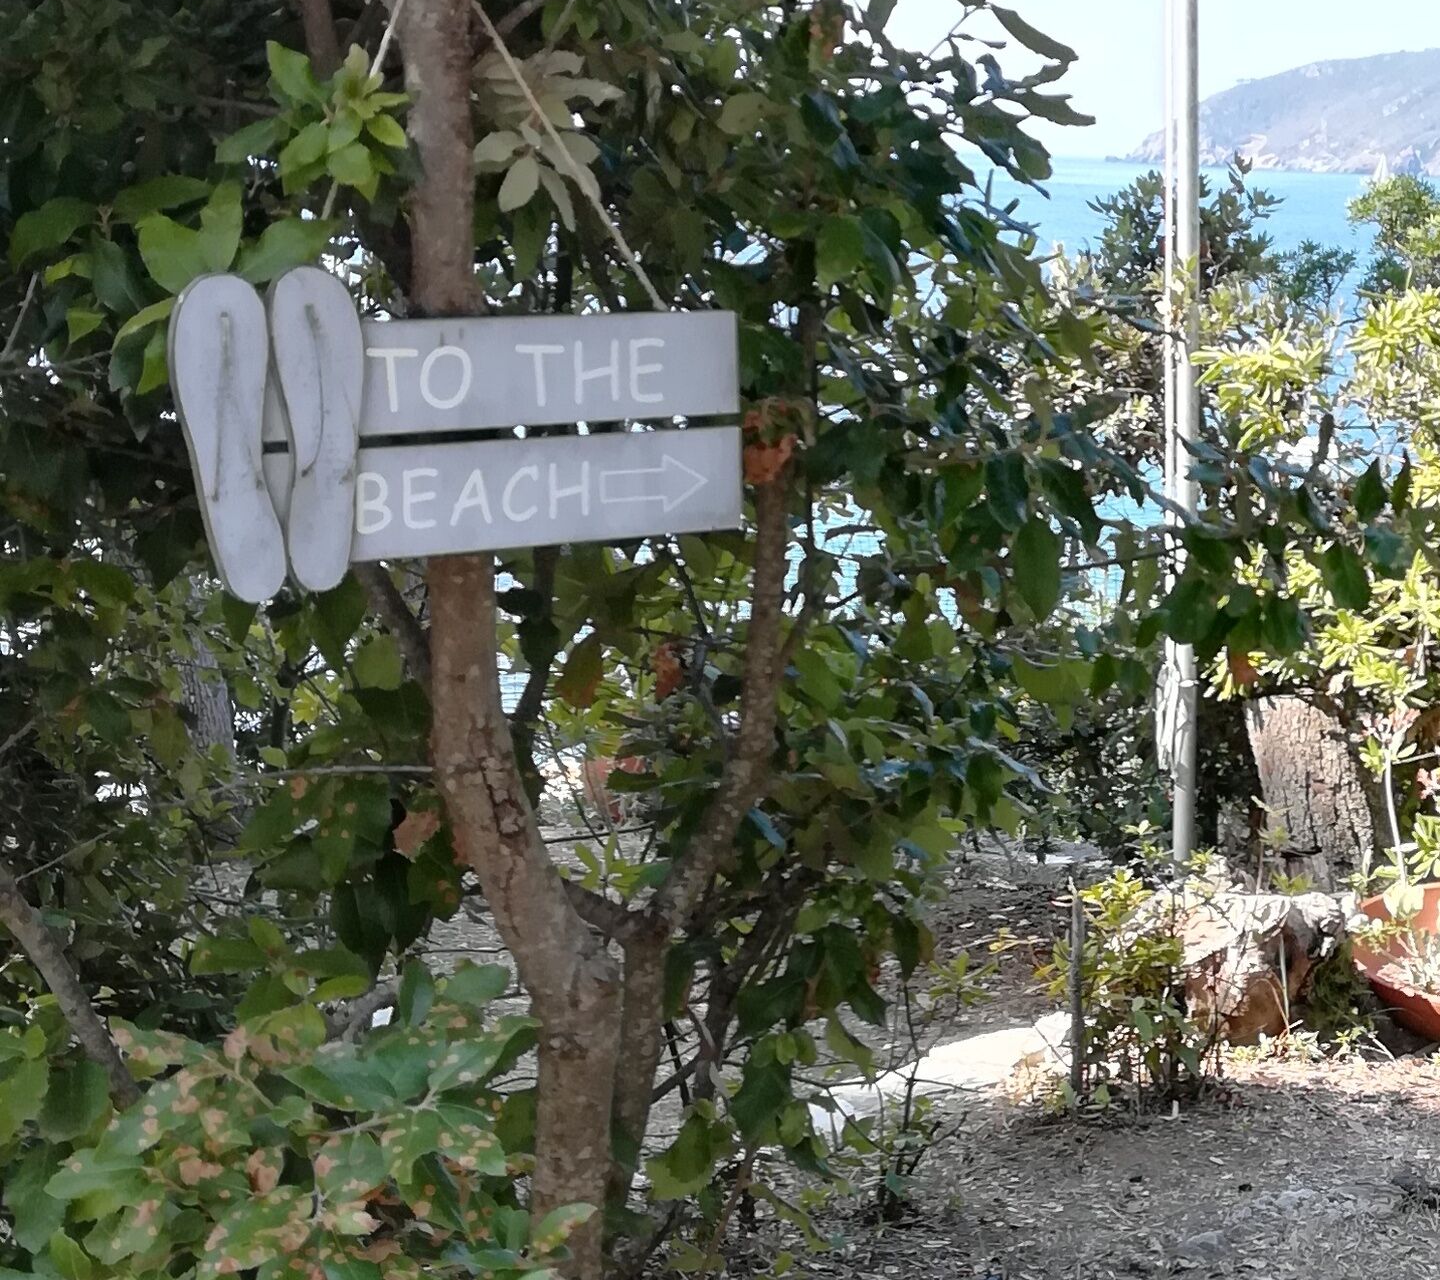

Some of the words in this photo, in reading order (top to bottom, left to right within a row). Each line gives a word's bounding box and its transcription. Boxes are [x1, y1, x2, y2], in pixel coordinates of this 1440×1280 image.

[366, 345, 472, 412] TO
[516, 338, 665, 406] THE
[356, 461, 590, 535] BEACH
